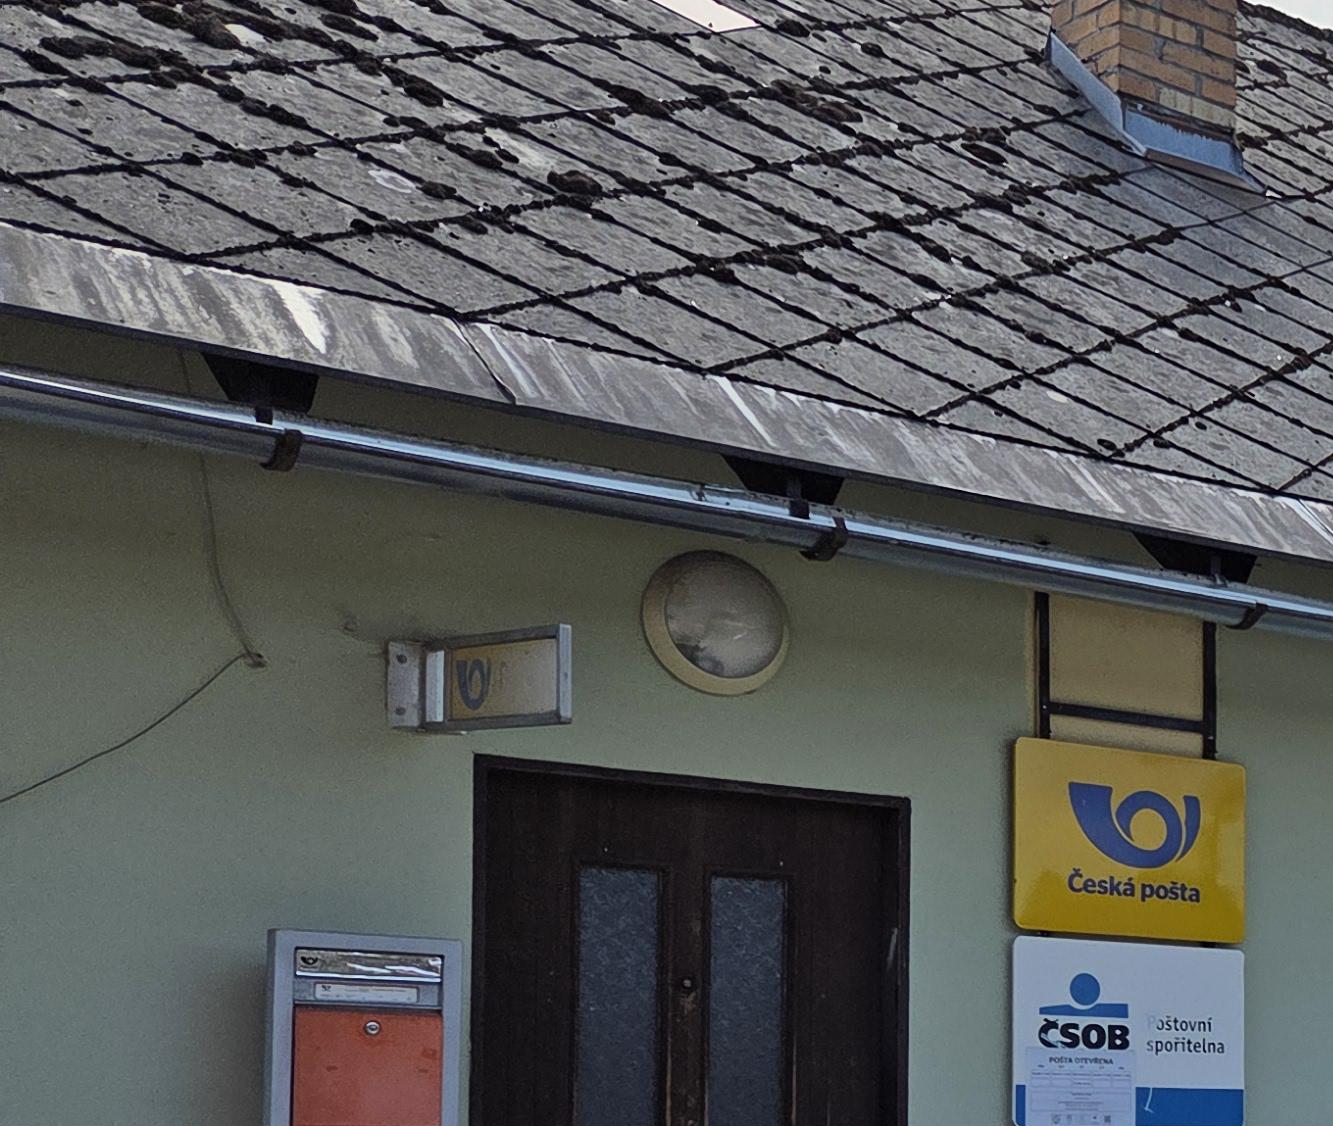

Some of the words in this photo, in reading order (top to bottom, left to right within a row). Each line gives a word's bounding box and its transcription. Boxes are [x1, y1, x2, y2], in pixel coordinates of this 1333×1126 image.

[1067, 867, 1135, 898] Česká
[1140, 881, 1201, 903] pošta
[1038, 1017, 1130, 1050] ČSOB
[1146, 1036, 1225, 1056] spořitelna
